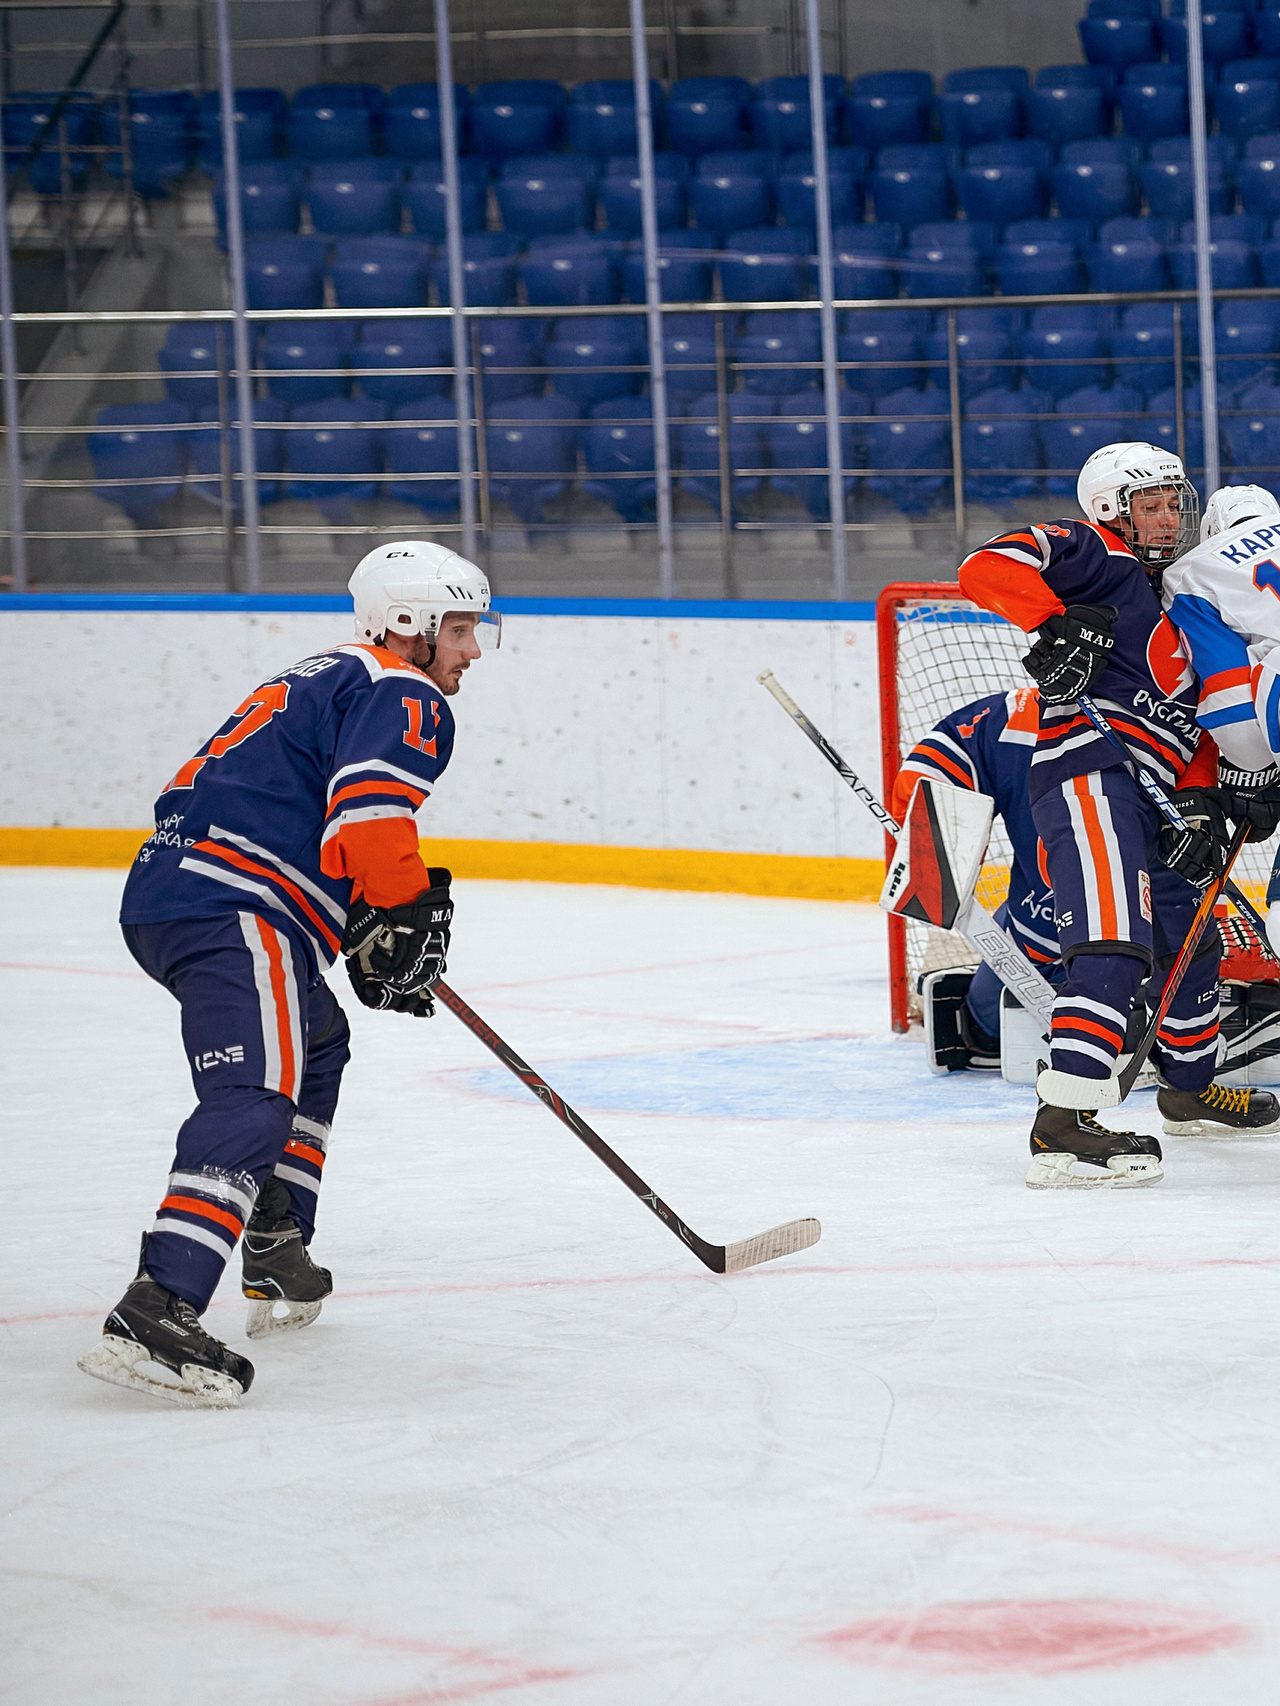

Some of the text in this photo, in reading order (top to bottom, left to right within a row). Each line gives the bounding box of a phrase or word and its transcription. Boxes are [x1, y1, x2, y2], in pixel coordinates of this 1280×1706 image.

[1079, 627, 1114, 649] MAD
[1133, 689, 1203, 748] РусГид
[1235, 898, 1257, 924] TEAM
[434, 982, 502, 1049] BAUER
